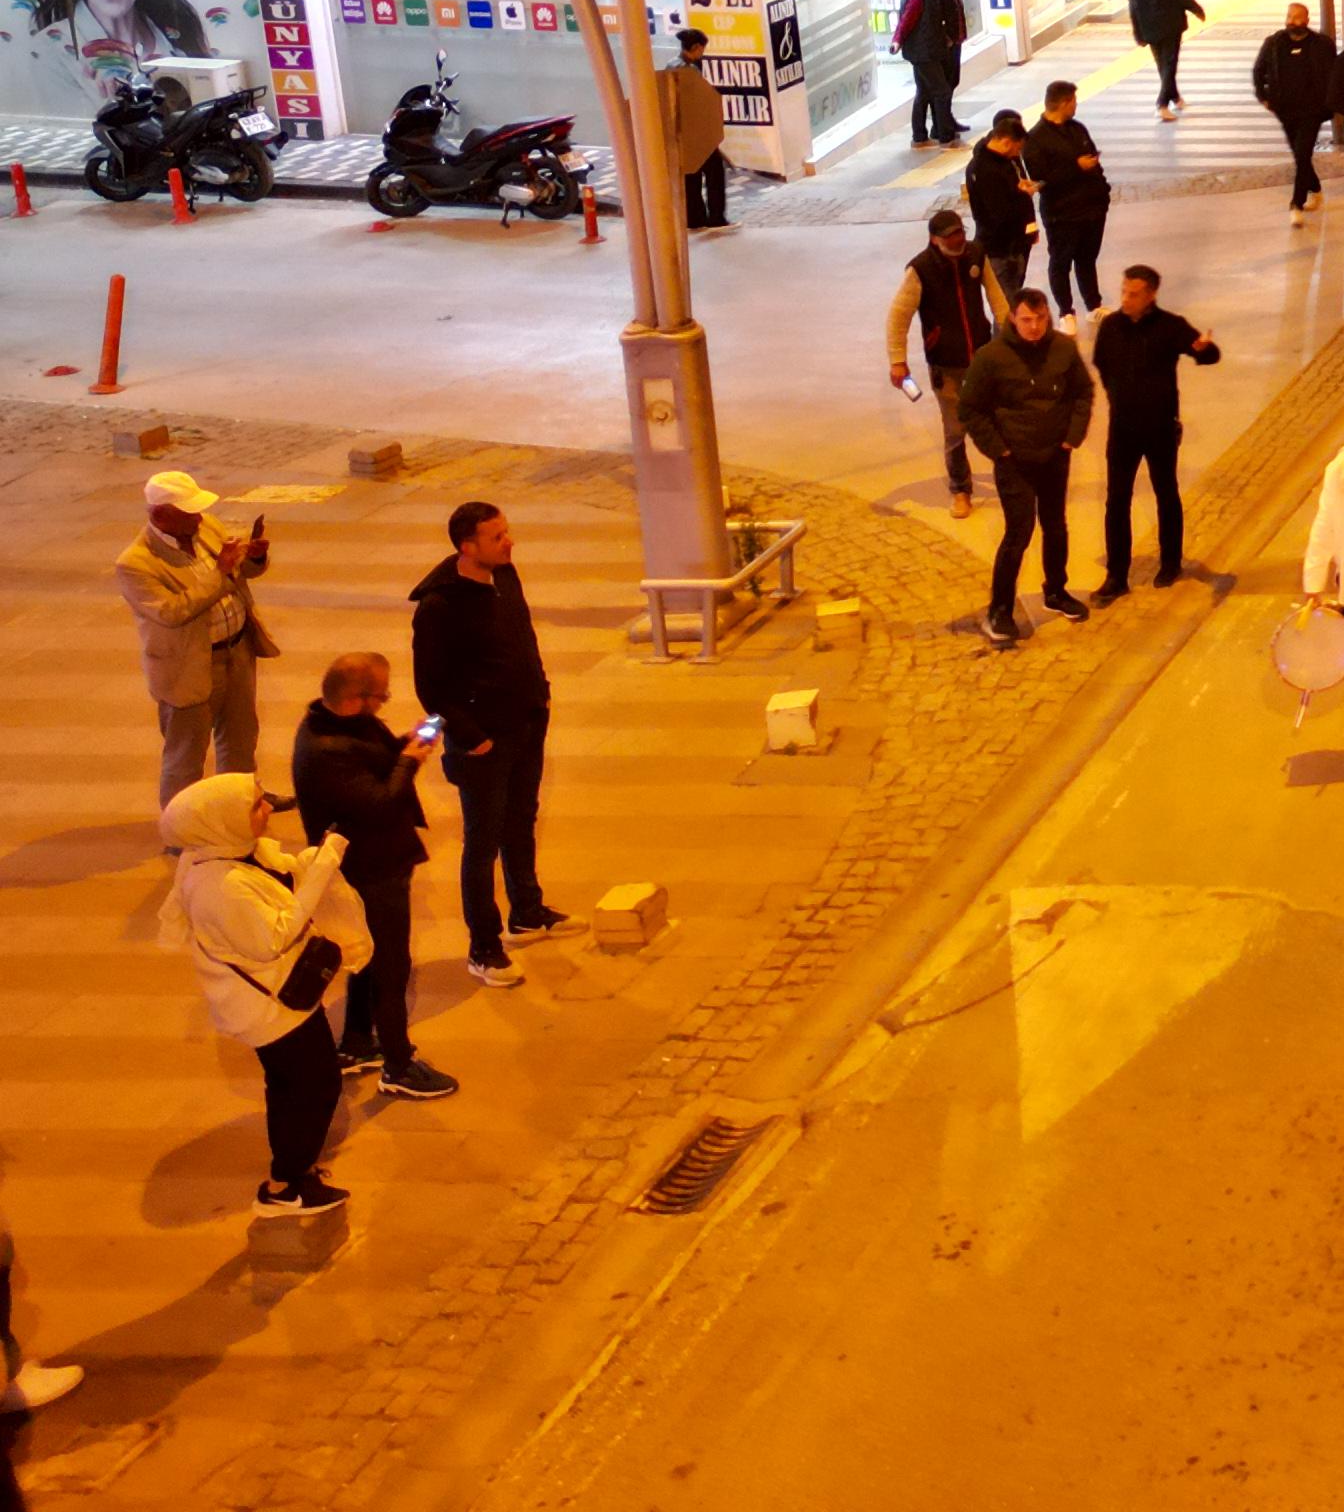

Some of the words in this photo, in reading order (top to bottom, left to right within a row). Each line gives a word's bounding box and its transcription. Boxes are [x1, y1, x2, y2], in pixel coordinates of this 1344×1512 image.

[770, 0, 794, 23] ALINIR
[702, 59, 763, 88] ALINIR
[722, 94, 772, 123] TILIR
